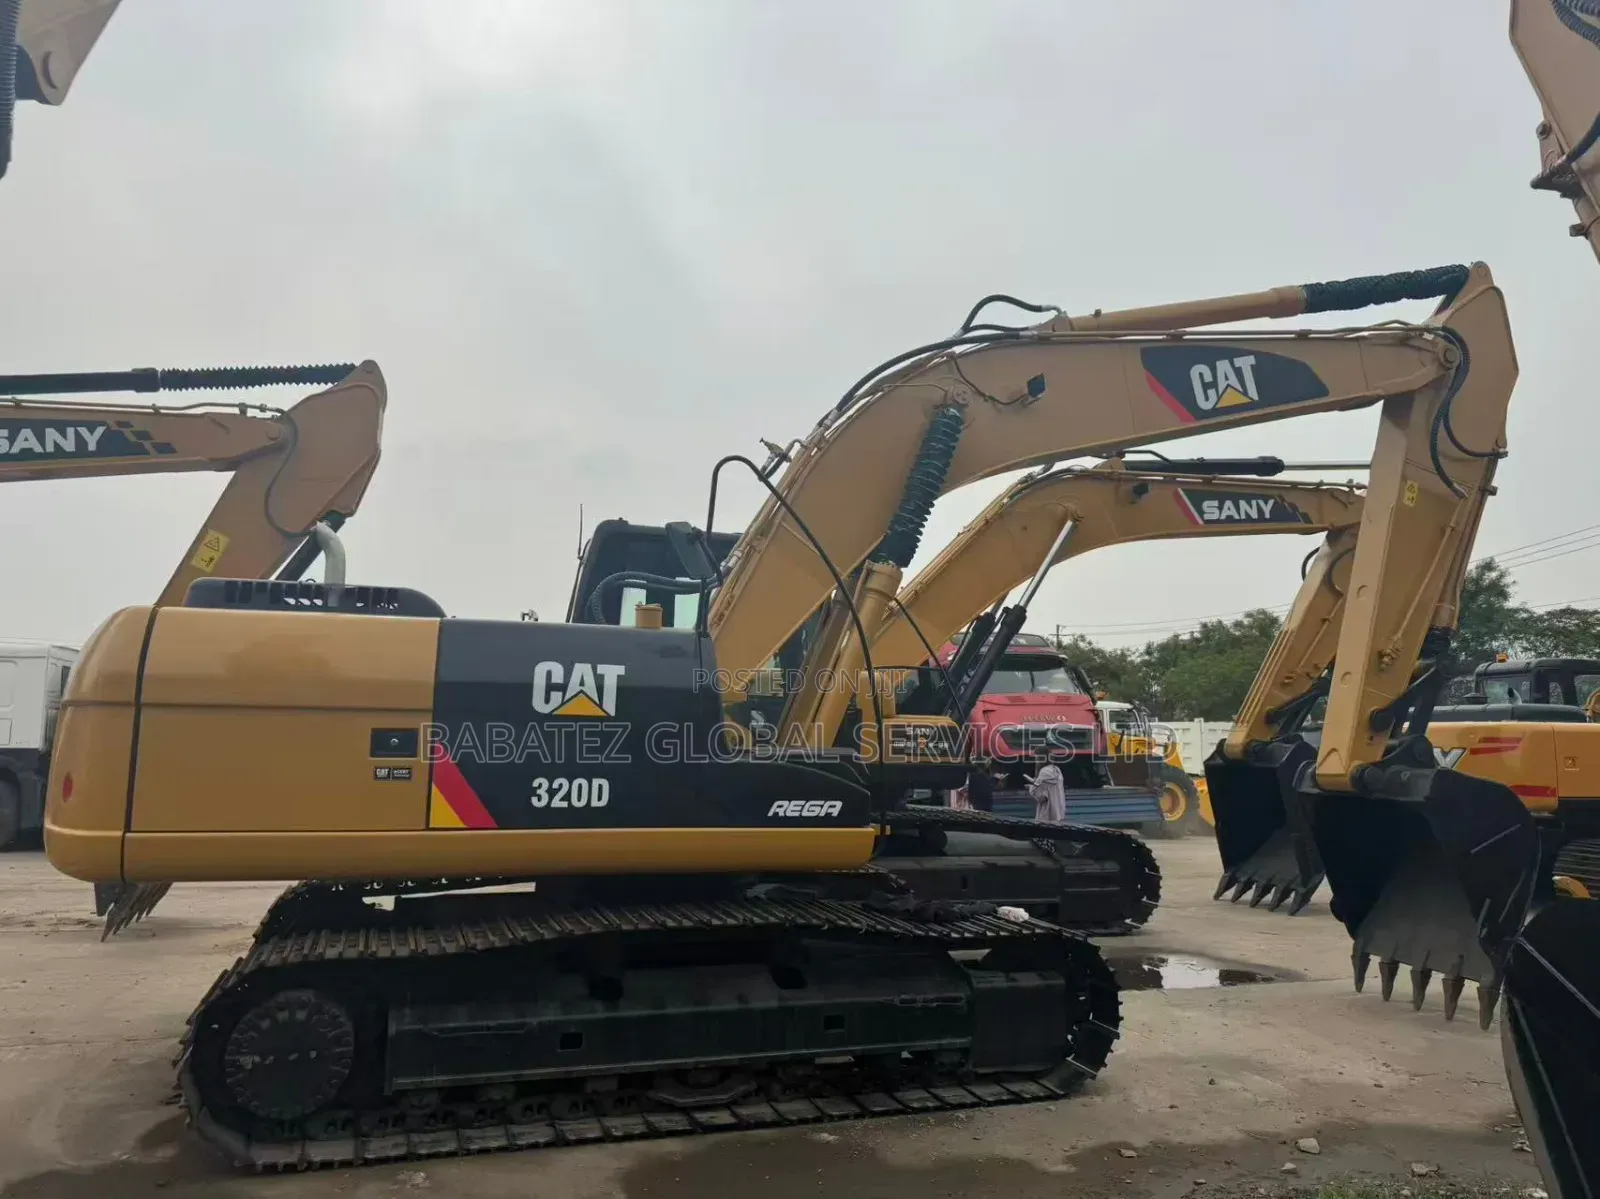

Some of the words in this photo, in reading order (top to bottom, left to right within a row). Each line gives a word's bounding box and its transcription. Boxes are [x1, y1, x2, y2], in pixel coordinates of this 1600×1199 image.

[1189, 355, 1259, 410] CAT
[1202, 498, 1275, 521] SANY
[531, 660, 626, 717] CAT
[905, 727, 937, 736] SANY
[531, 777, 610, 808] 320D
[767, 800, 843, 817] REGA
